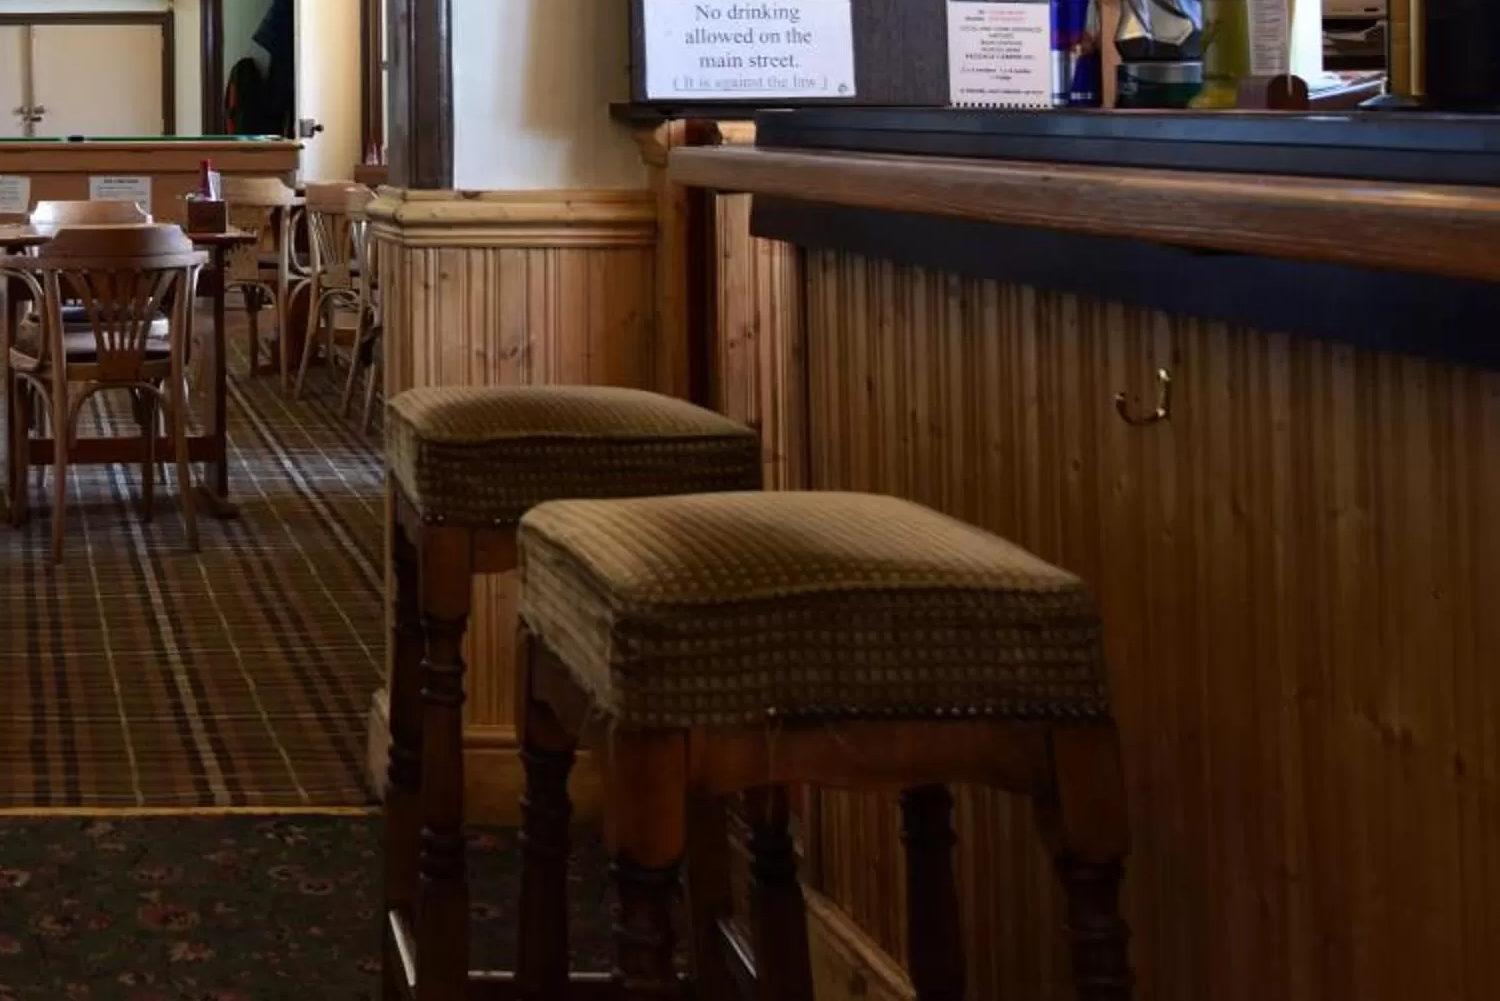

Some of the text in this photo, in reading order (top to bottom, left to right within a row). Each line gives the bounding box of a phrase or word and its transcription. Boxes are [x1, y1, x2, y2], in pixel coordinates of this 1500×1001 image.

[694, 4, 801, 23] No drinking
[685, 28, 812, 45] allowed on the
[699, 52, 800, 68] main street.
[767, 75, 790, 89] the
